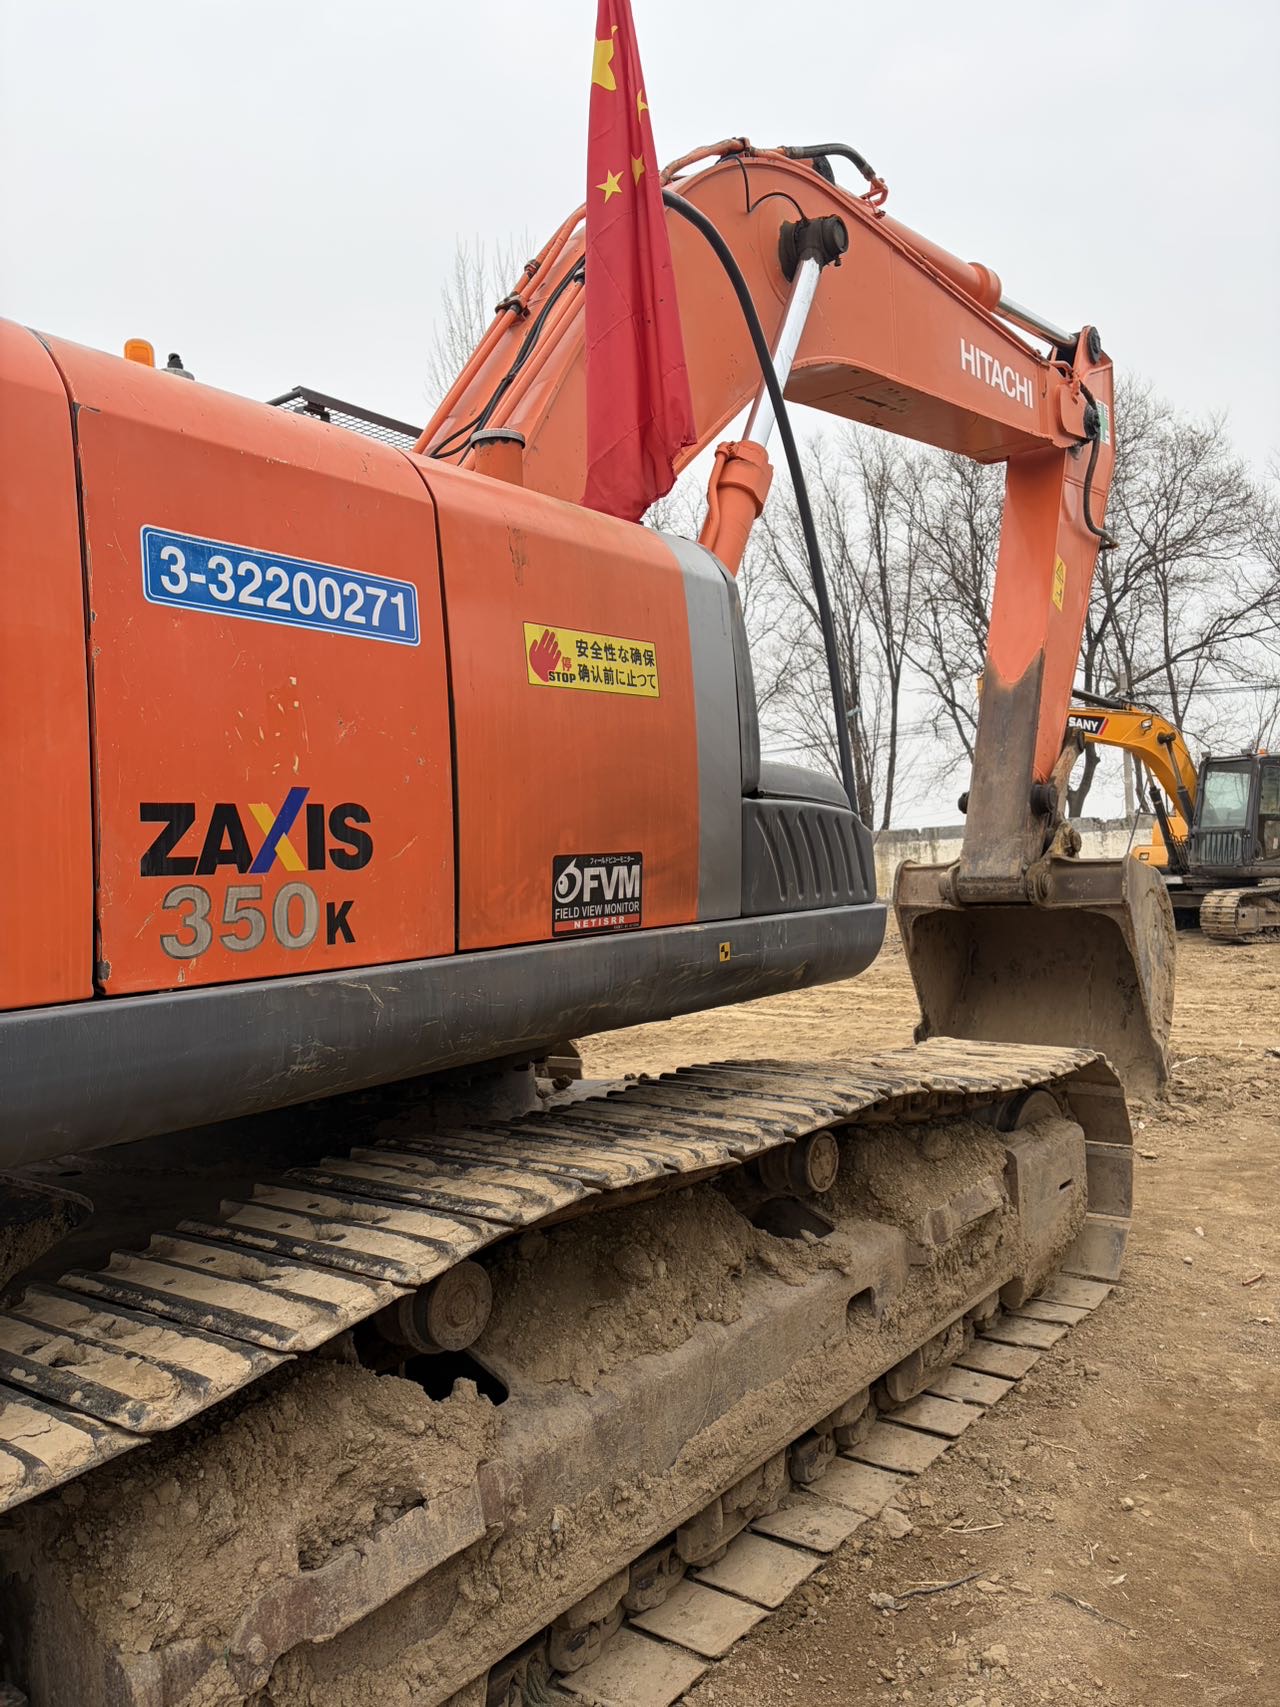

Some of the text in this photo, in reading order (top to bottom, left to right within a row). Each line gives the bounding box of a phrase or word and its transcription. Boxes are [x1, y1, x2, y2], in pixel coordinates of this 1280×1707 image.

[960, 338, 1033, 409] HITACHI
[160, 545, 406, 631] 3-32200271
[548, 670, 576, 683] STOP
[1068, 716, 1098, 732] SANY
[140, 786, 374, 877] ZAXIS
[555, 900, 640, 920] FIELD VIEW MONITOR
[583, 864, 640, 902] FVM
[160, 881, 356, 960] 350 K
